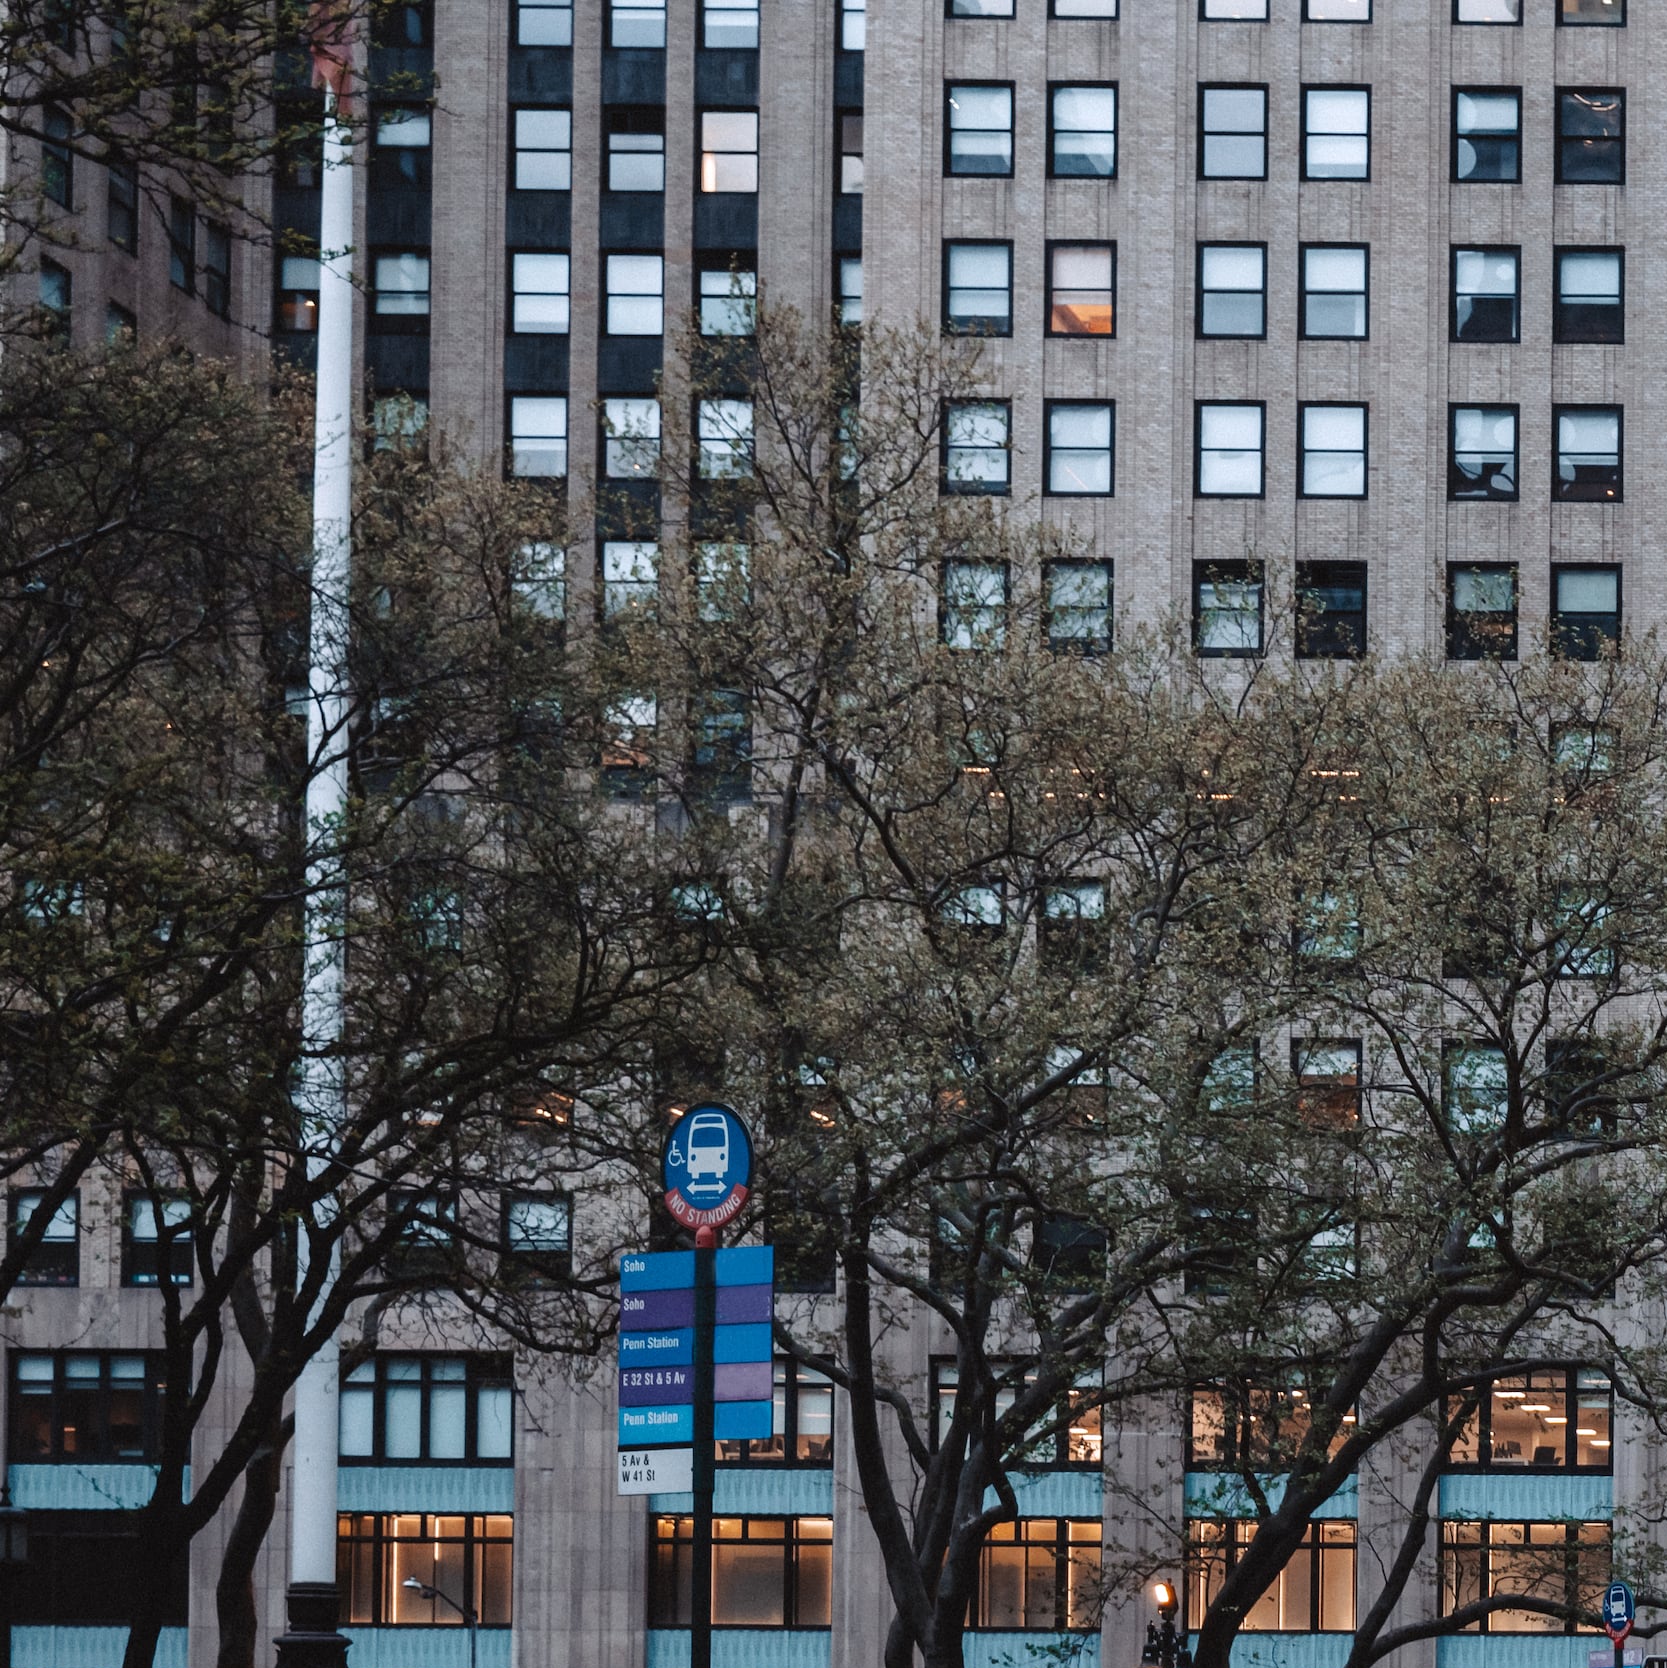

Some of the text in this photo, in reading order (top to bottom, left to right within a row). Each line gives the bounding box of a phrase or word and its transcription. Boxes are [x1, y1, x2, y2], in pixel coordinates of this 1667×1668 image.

[670, 1193, 741, 1225] NO STANDING
[623, 1259, 646, 1273] Soho
[623, 1298, 645, 1311] Soho
[623, 1336, 680, 1350] Penn Station
[623, 1371, 686, 1387] E 32 St & 5 Av
[623, 1411, 679, 1426] Penn Station
[622, 1454, 650, 1467] 5 Av &
[622, 1469, 655, 1482] W 41 St
